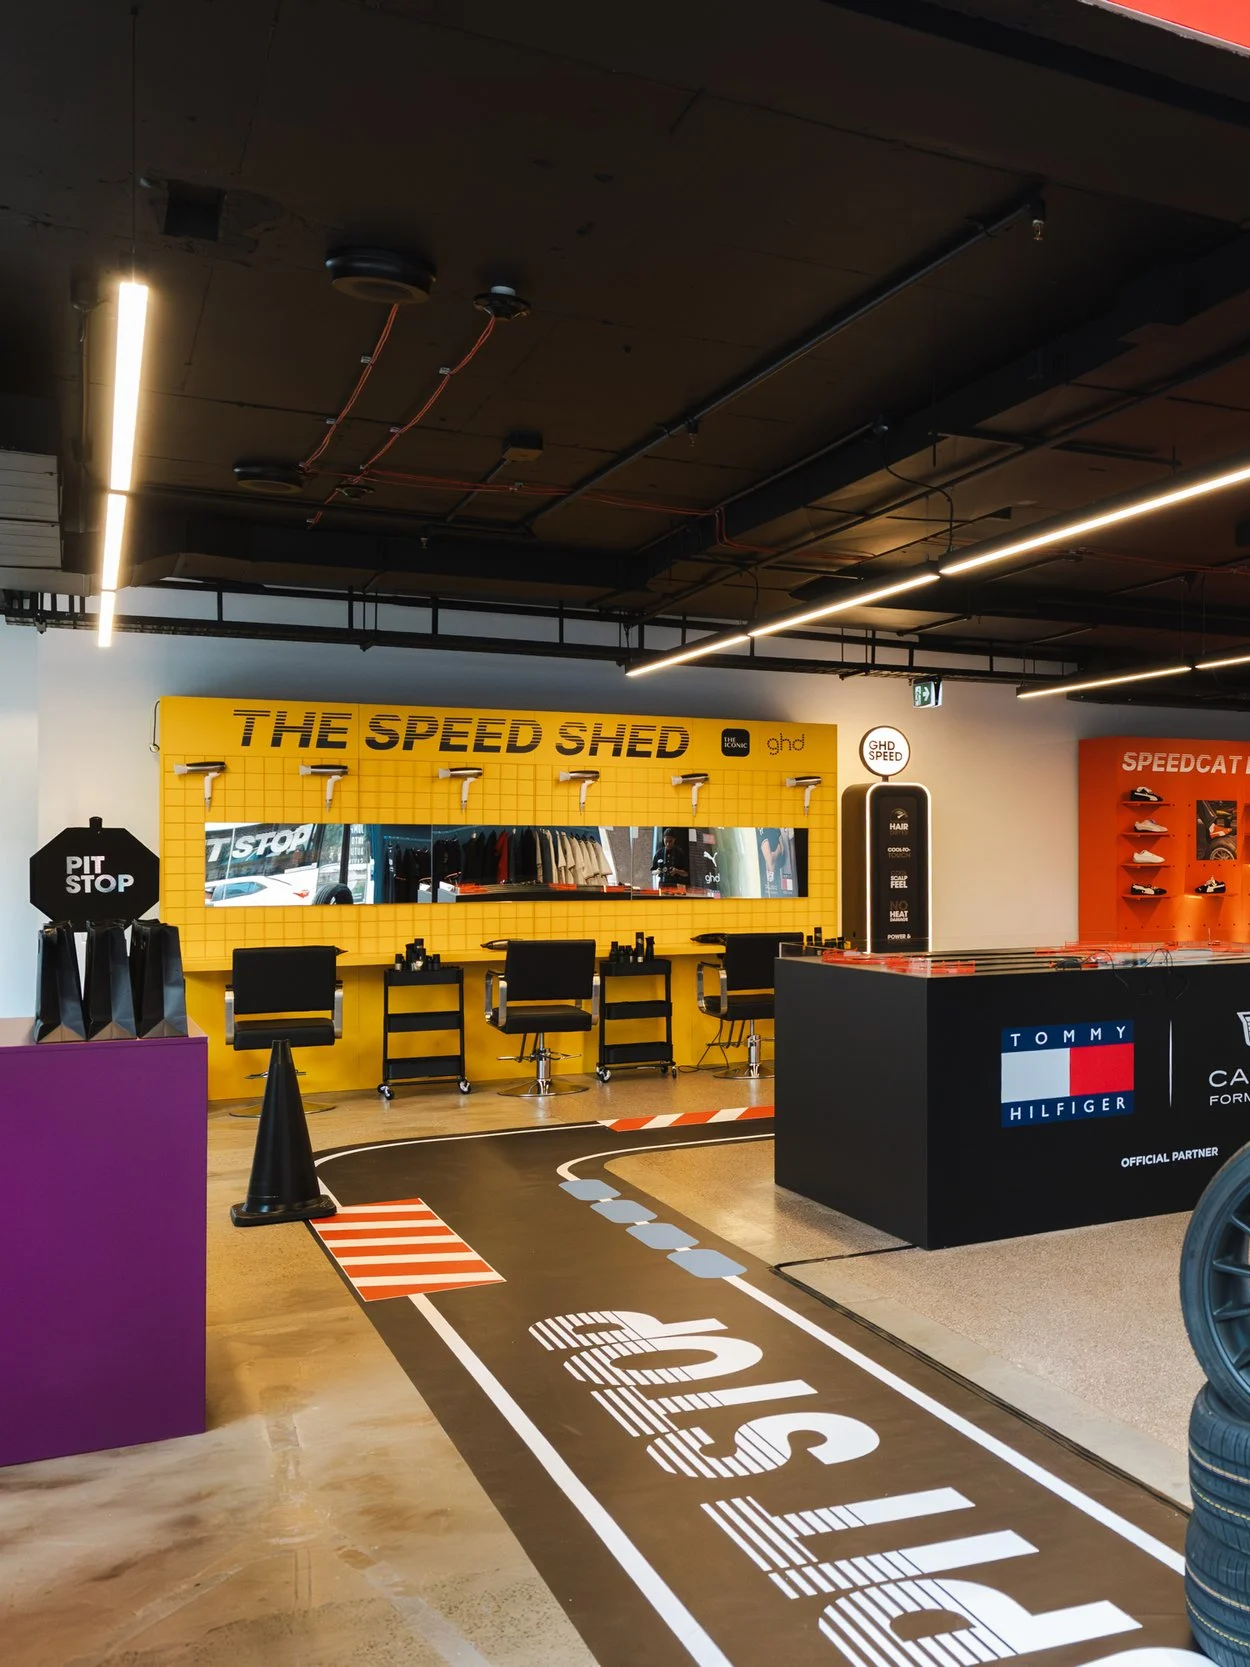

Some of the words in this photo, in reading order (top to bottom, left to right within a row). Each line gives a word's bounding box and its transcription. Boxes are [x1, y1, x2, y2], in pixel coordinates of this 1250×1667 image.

[233, 709, 352, 749] THE
[365, 714, 542, 753] SPEED
[555, 721, 690, 758] SHED
[767, 732, 805, 756] ghd
[869, 740, 895, 751] GHD
[869, 750, 903, 761] SPEED
[1122, 751, 1243, 774] SPEEDCAT
[889, 823, 909, 831] HAIR
[232, 824, 313, 859] STOP
[66, 856, 105, 874] PIT
[65, 873, 134, 894] STOP
[705, 872, 720, 883] ghd
[890, 881, 908, 889] FEEL
[1010, 1026, 1126, 1047] TOMMY
[1010, 1096, 1126, 1121] HILFIGER
[1121, 1150, 1170, 1168] OFFICIAL
[1172, 1147, 1219, 1162] PARTNER
[528, 1310, 881, 1478] STOP
[702, 1487, 1143, 1667] PIT
